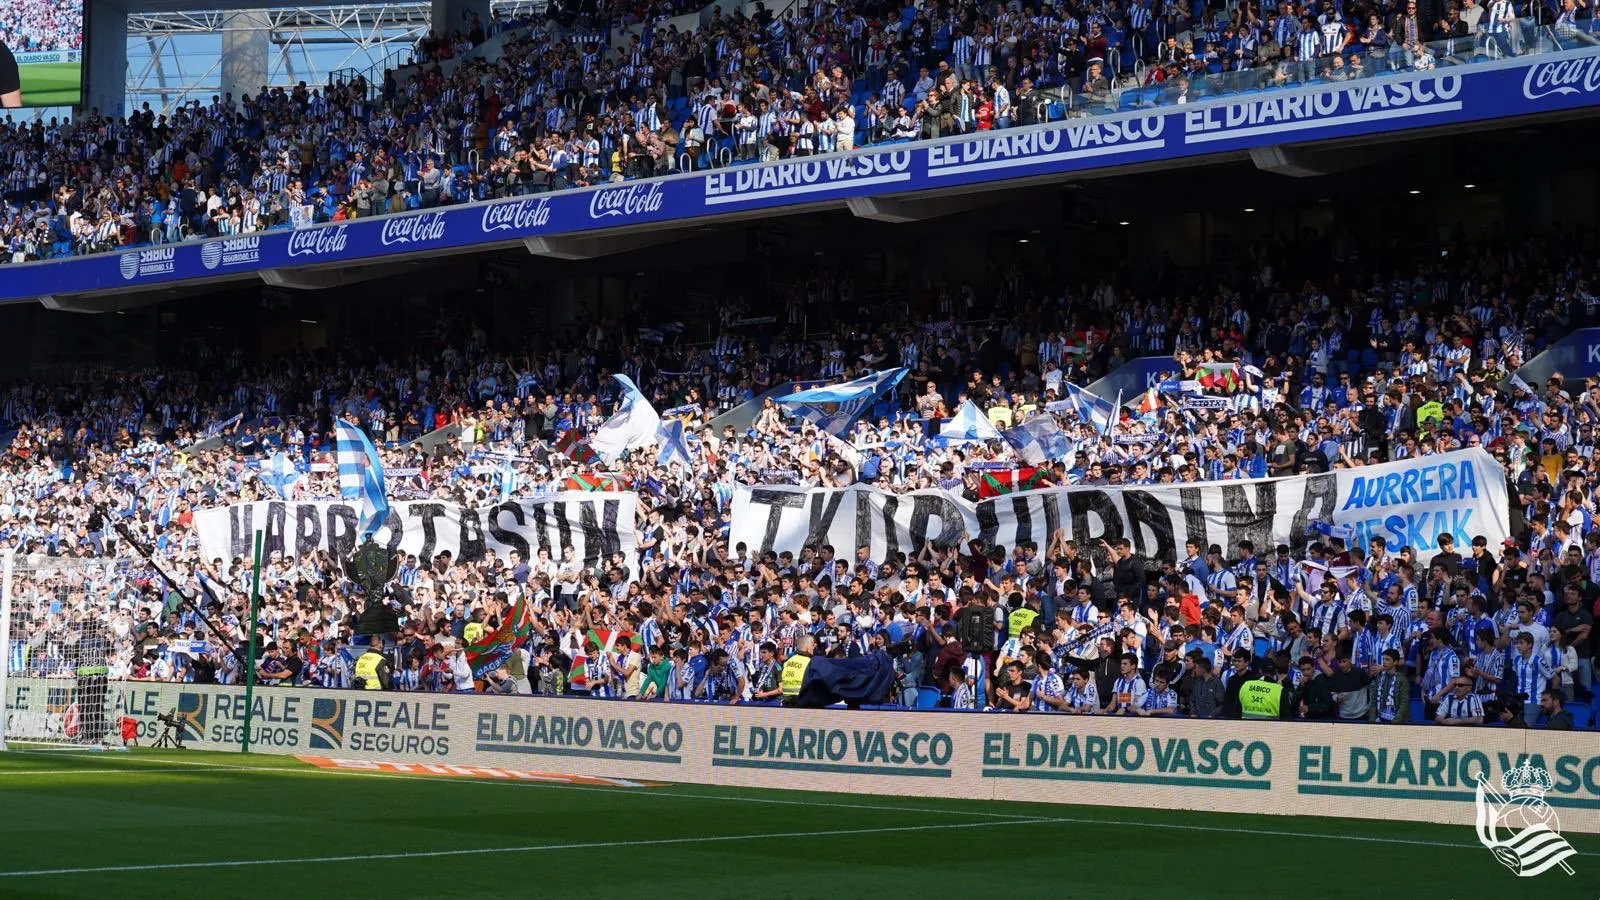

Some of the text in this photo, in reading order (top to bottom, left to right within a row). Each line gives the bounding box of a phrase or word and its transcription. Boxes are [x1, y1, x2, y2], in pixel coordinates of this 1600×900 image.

[1185, 74, 1462, 133] EL DIARIO VASCO
[927, 116, 1165, 166] EL DIARIO VASCO
[705, 150, 911, 196] EL DIARIO VASCO
[1341, 459, 1479, 512] AURRERA
[213, 693, 301, 723] REALE
[1248, 684, 1271, 694] SABICO
[211, 724, 299, 747] SEGUROS
[353, 699, 451, 731] REALE
[475, 712, 683, 752] EL DIARIO VASCO
[350, 732, 450, 756] SEGUROS
[713, 724, 953, 766] EL DIARIO VASCO
[982, 732, 1273, 777] EL DIARIO VASCO
[1298, 745, 1343, 782] EL
[1349, 746, 1492, 789] DIARIO
